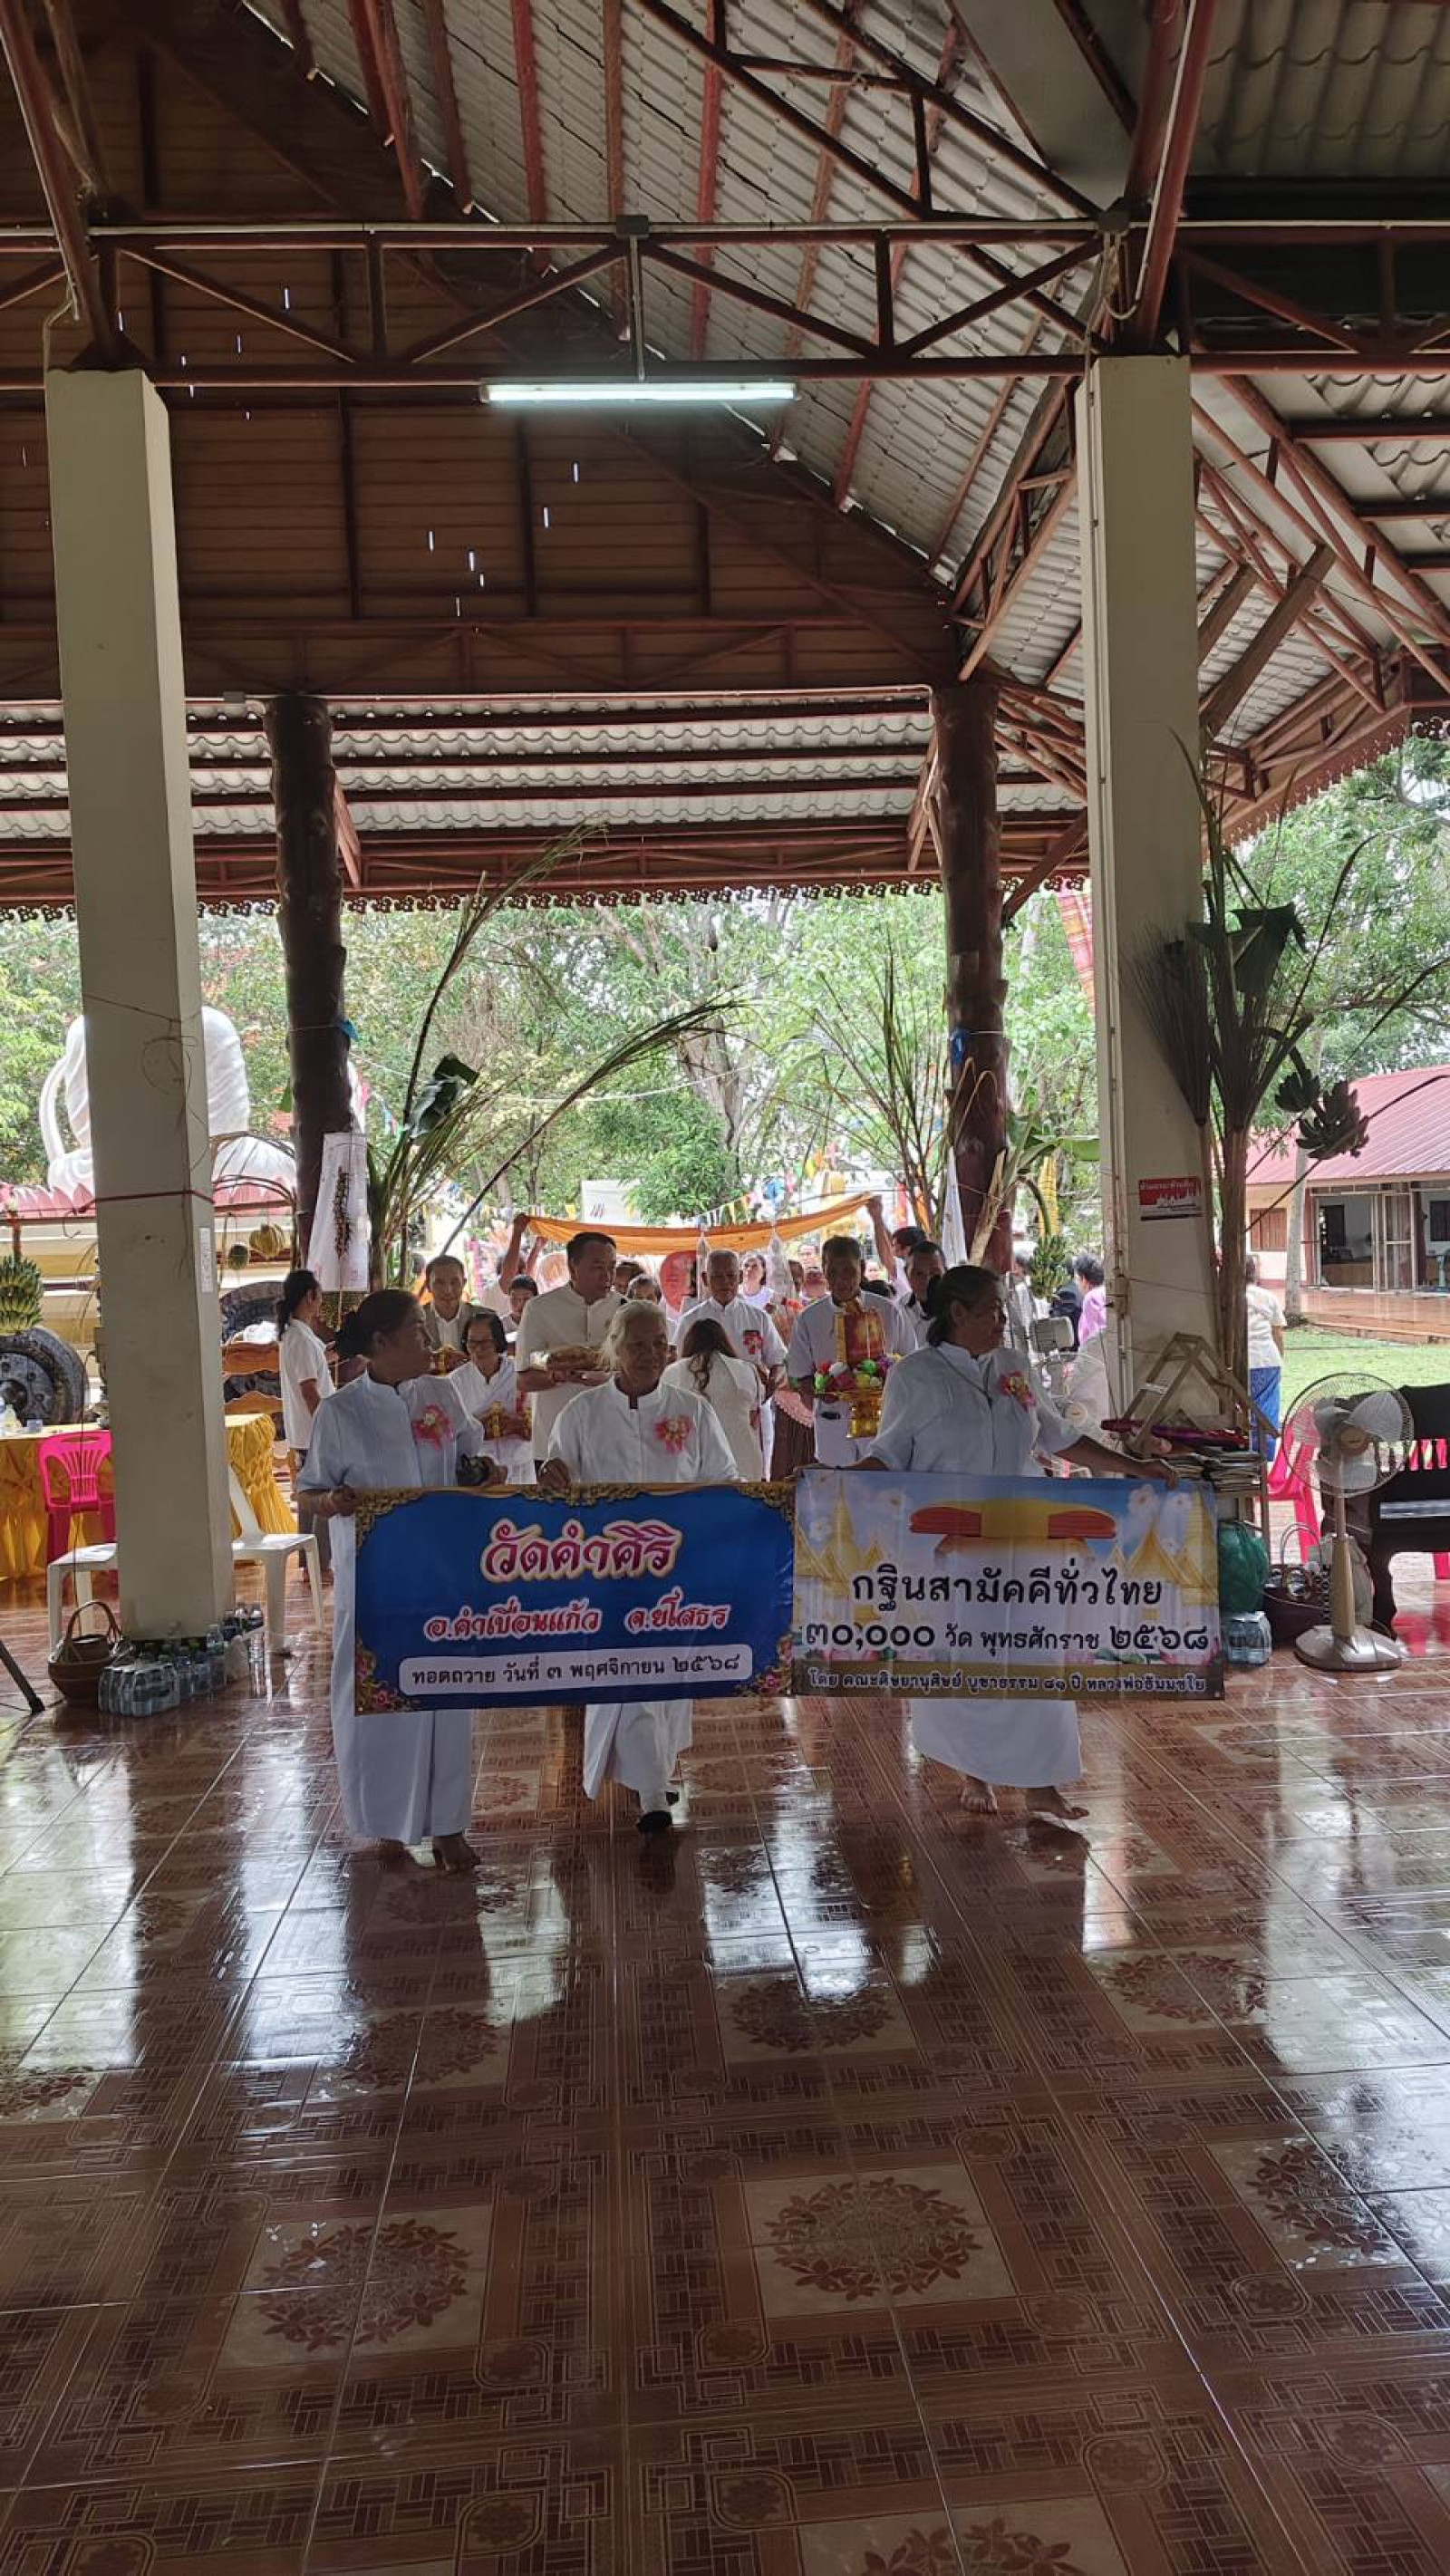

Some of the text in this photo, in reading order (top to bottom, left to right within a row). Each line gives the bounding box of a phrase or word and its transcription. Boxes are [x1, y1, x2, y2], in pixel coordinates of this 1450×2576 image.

[483, 1520, 681, 1580] วัดคำศิริ
[852, 1558, 1162, 1611] กฐินสามัคคีทั่วไทย
[425, 1587, 730, 1641] อ.คำเขื่อนแก้ว จ.ยโสธร
[945, 1624, 972, 1648] วัด
[981, 1626, 1100, 1656] พุทธศักราช
[1109, 1624, 1209, 1651] ๒๕๖๘
[412, 1654, 741, 1685] ทอดถวาย วันที่ ๓ พฤศจิกายน ๒๕๖๘
[808, 1667, 838, 1687] โดย
[1070, 1672, 1083, 1692] ปี
